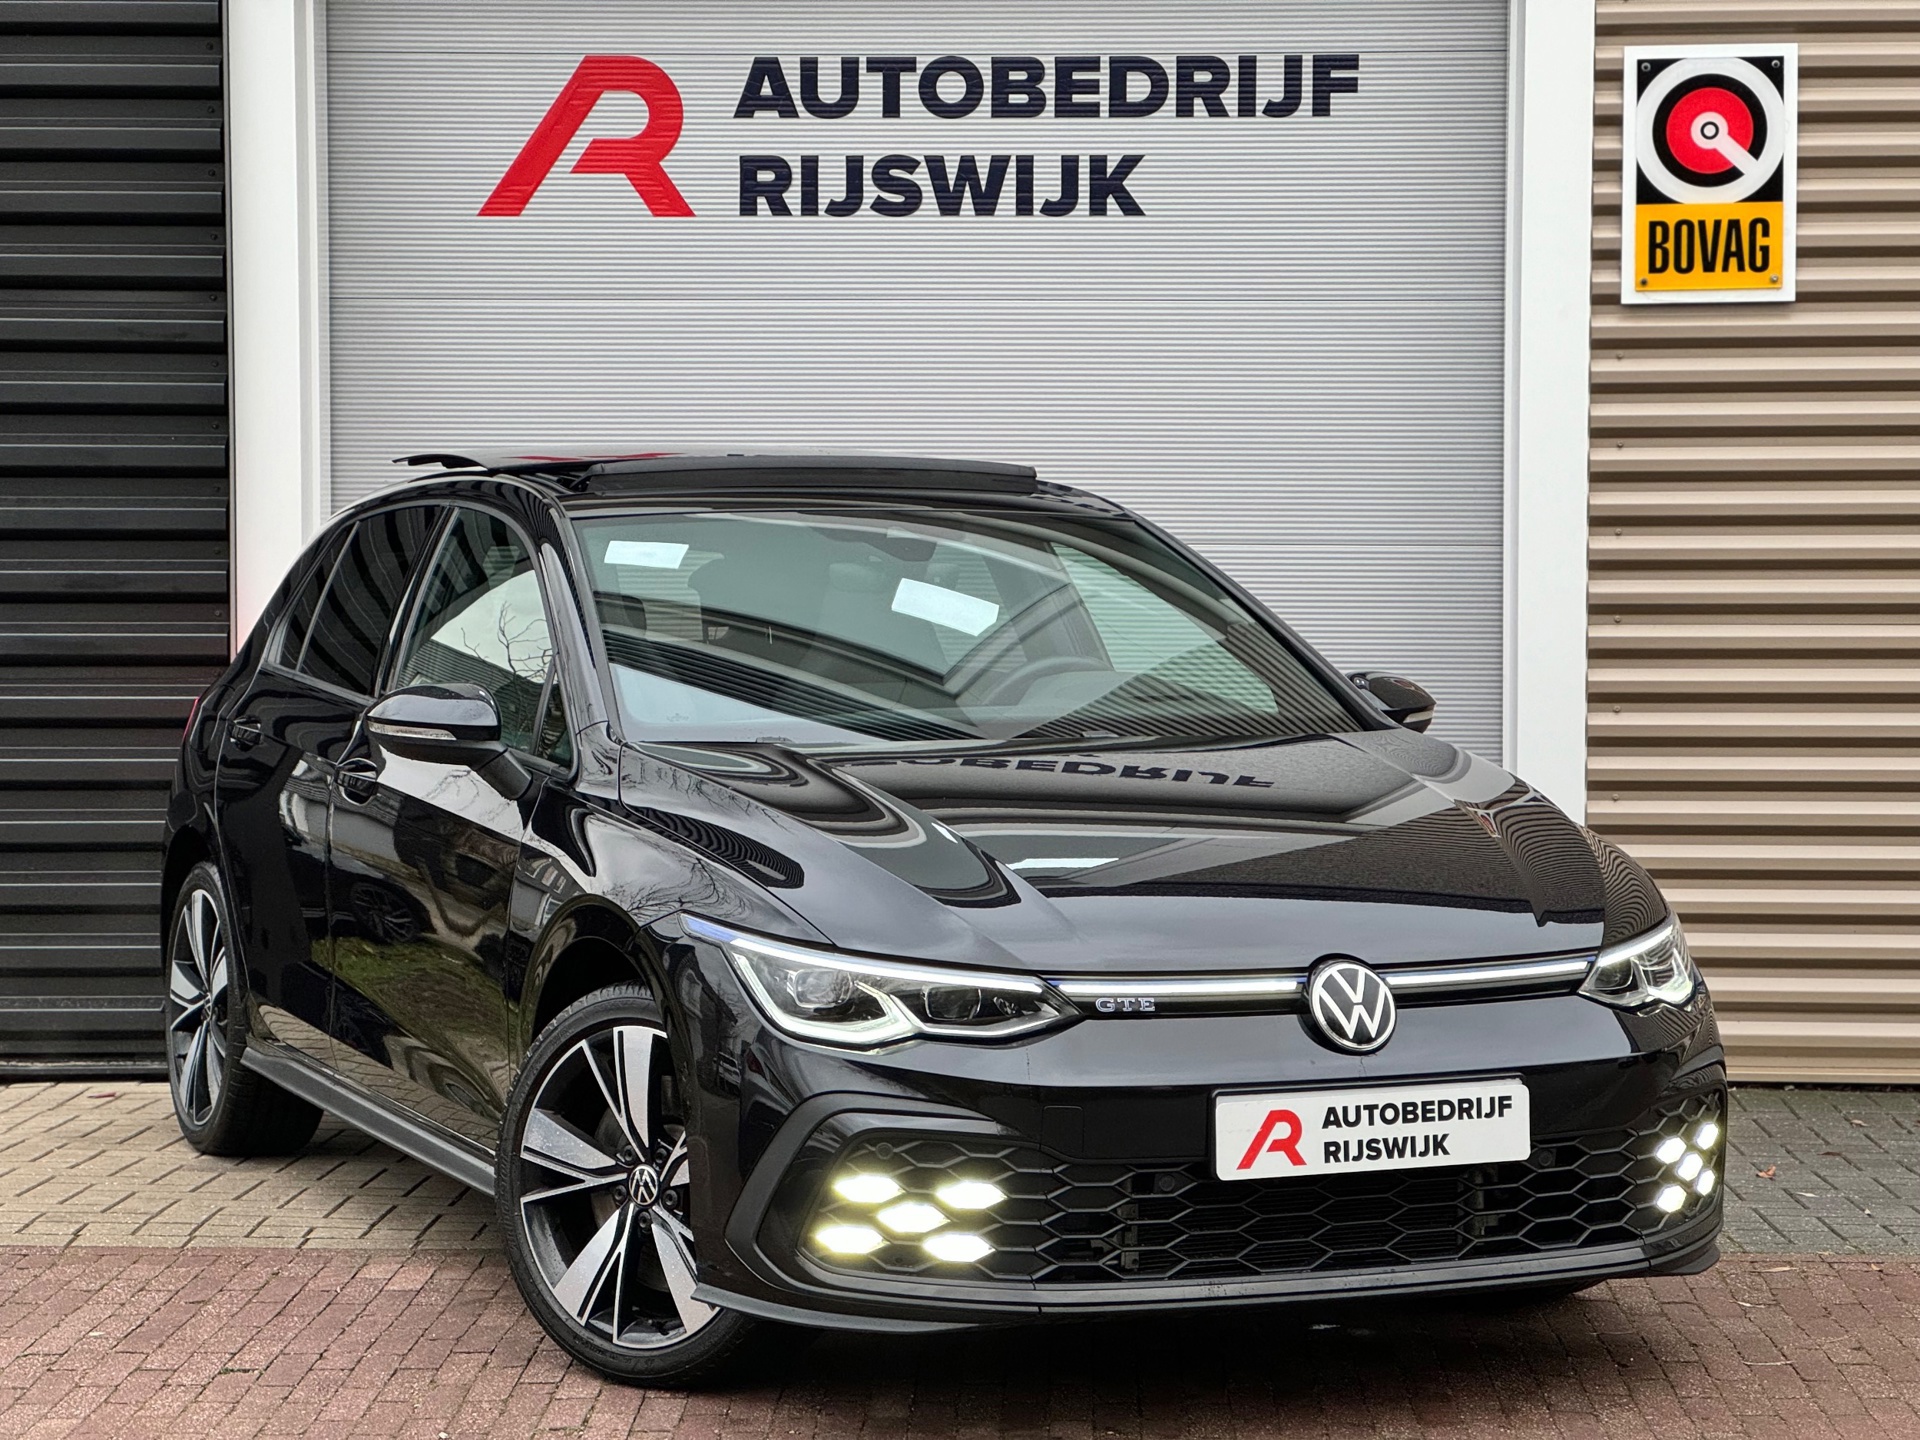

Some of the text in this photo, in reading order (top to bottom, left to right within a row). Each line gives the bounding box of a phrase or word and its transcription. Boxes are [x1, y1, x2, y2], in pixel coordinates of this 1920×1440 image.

[732, 53, 1360, 120] AUTOBEDRIJF
[738, 153, 1146, 218] RIJSWIJK
[1648, 217, 1771, 275] BOVAG
[1095, 997, 1156, 1013] GTE
[1321, 1095, 1513, 1130] AUTOBEDRIJF
[1323, 1133, 1451, 1164] RIJSWIJK
